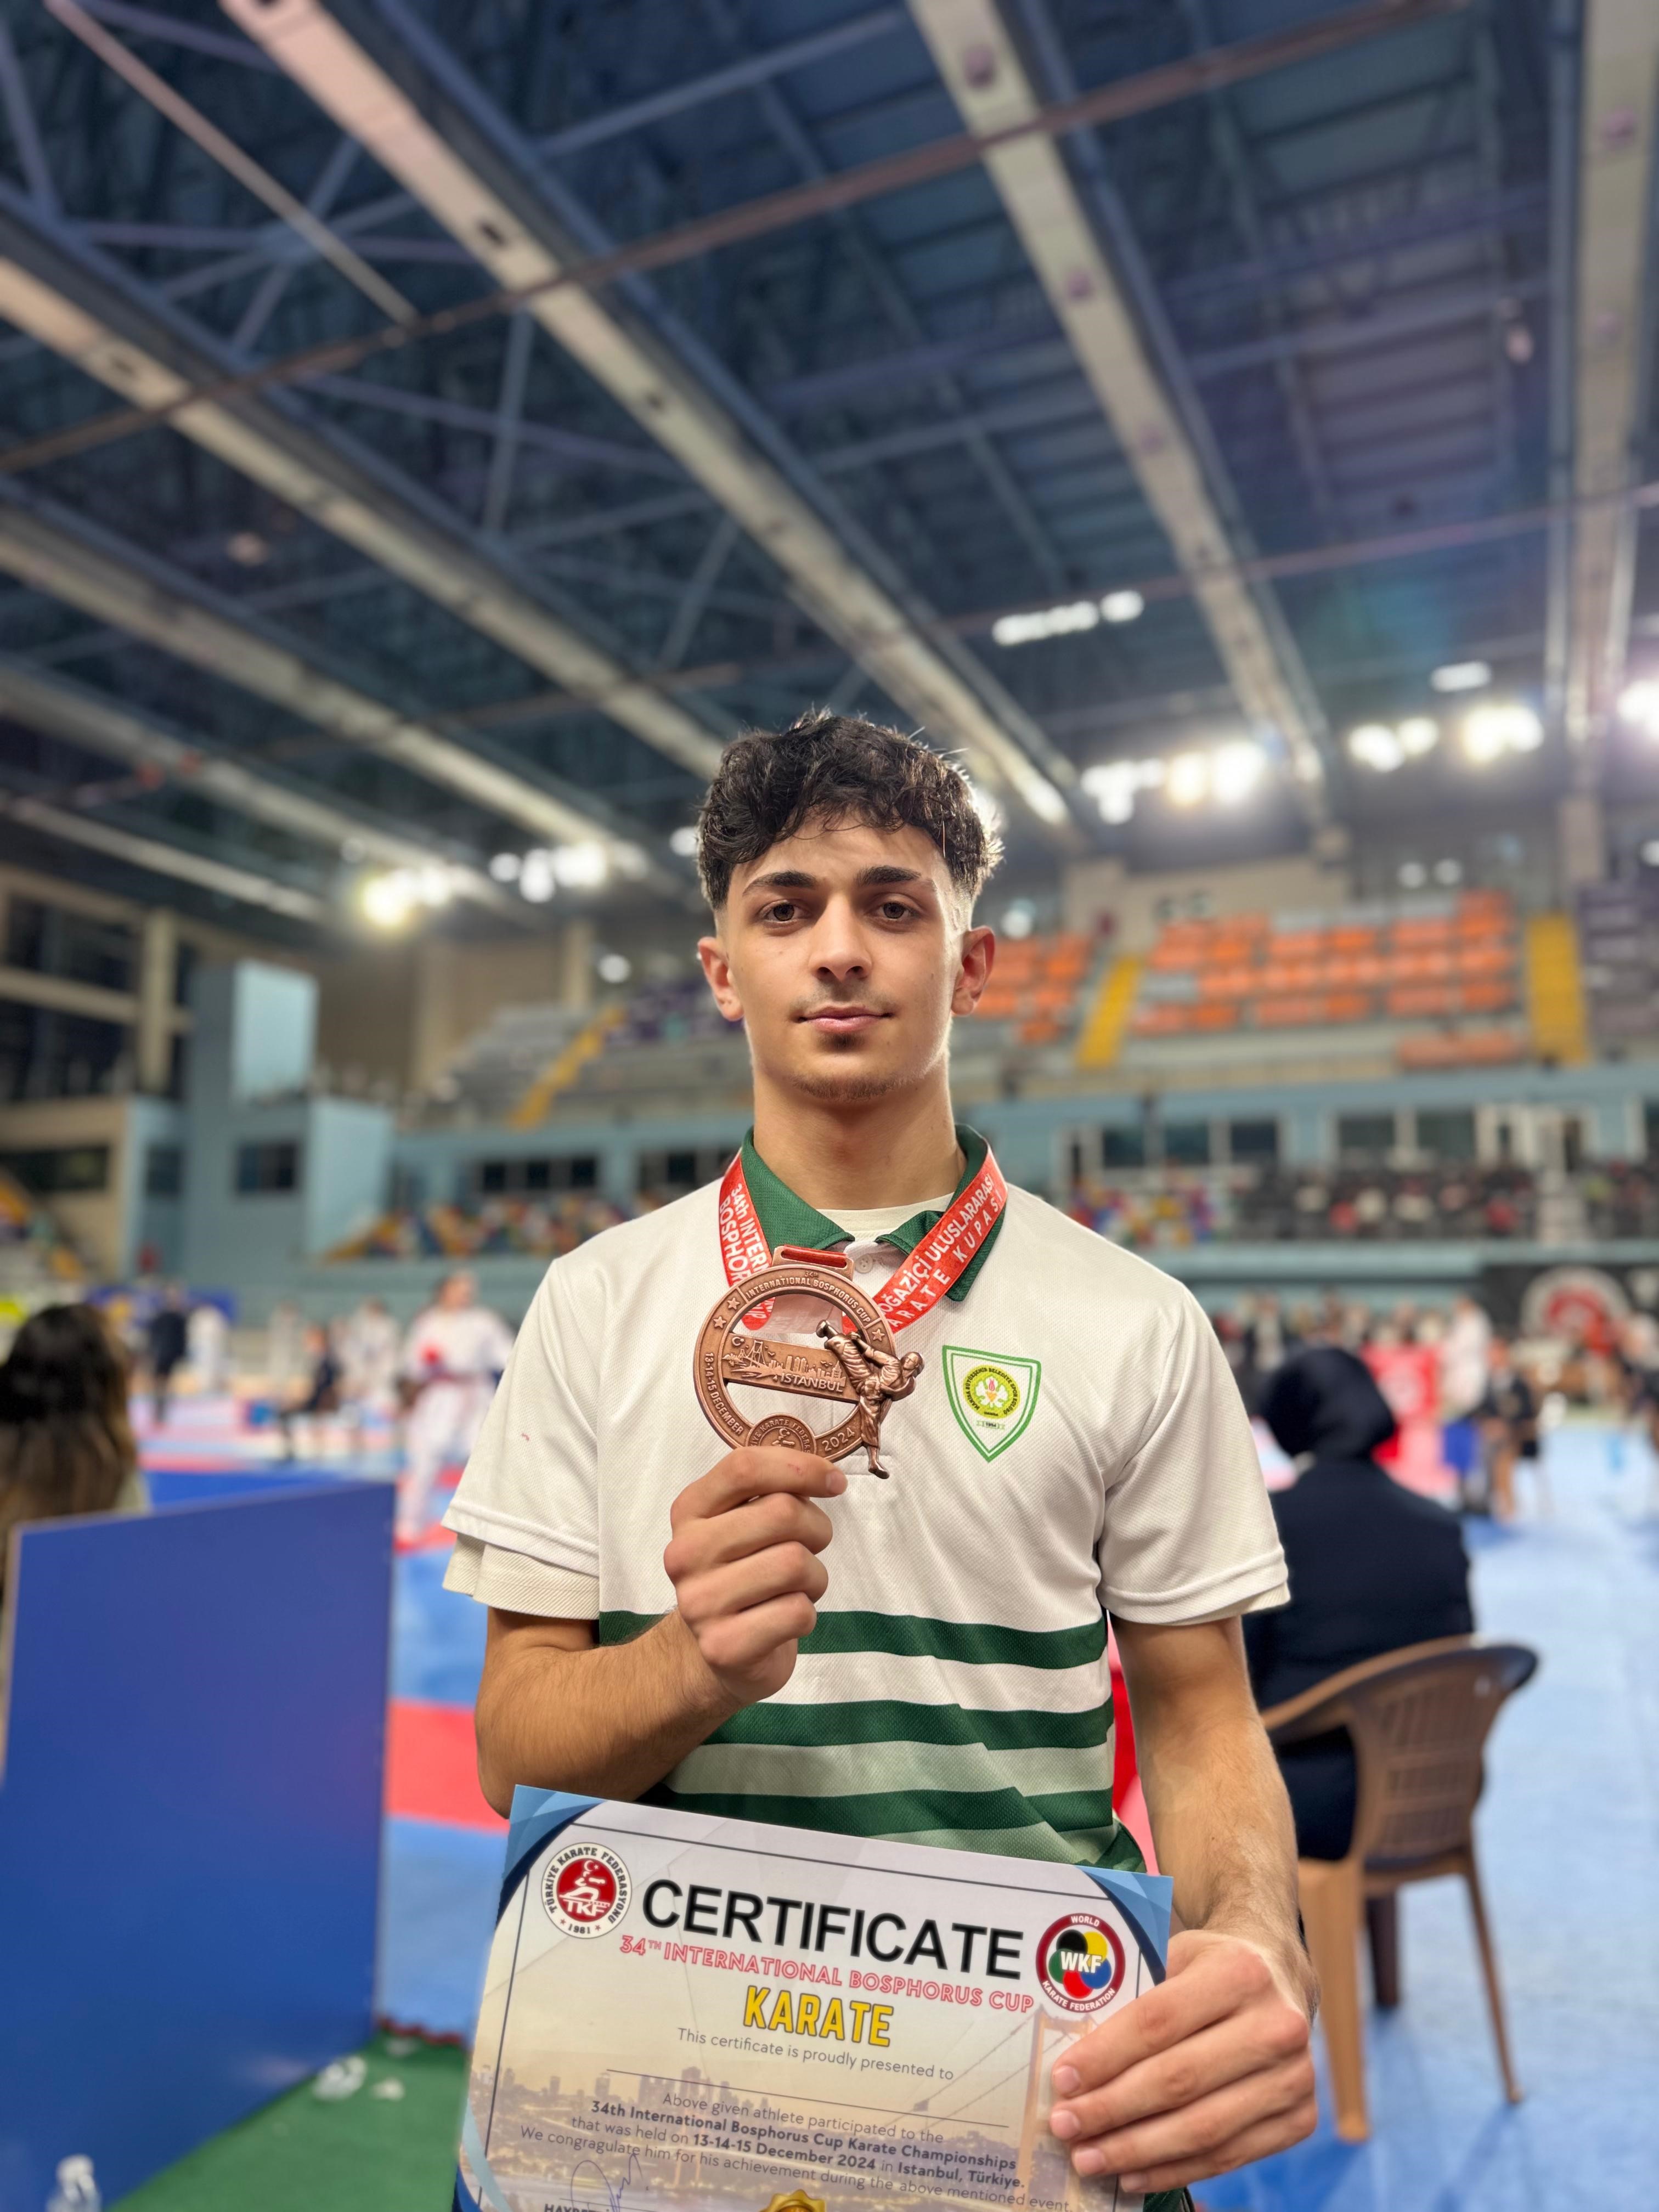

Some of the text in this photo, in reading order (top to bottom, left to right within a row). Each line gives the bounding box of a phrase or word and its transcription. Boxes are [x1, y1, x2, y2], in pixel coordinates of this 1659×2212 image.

[731, 1183, 749, 1220] 34th
[720, 1196, 752, 1281] BOSPHOR
[878, 1175, 994, 1314] OĞAZİÇİ ULUSLARARASI
[746, 1277, 871, 1323] INTERNATIONAL BOSPHORUS CUP
[887, 1268, 951, 1328] ARATE
[710, 1391, 744, 1435] DECEMBER
[759, 1419, 790, 1432] KARATE
[822, 1427, 855, 1452] 2024
[544, 1847, 628, 1924] TÜRKİYE KARATE FEDERASYONU
[563, 1899, 610, 1917] TKF
[568, 1923, 591, 1934] 1981
[642, 1879, 1024, 1980] CERTIFICATE
[1071, 1915, 1101, 1927] WORLD
[664, 1942, 843, 1987] INTERNATIONAL
[849, 1970, 984, 2006] BOSPHORUS
[989, 1990, 1034, 2013] CUP
[1060, 1951, 1103, 1974] WKF
[743, 1985, 894, 2047] KARATE
[1042, 1980, 1116, 2011] KARATE FEDERATION
[678, 2027, 954, 2080] This certificate is proudly presented to
[591, 2100, 1017, 2170] 34th International Bosphorus Cup Karate Championships
[663, 2092, 944, 2143] Above given athlete participated to the
[521, 2125, 544, 2141] We
[549, 2133, 641, 2155] congragulate
[645, 2145, 670, 2160] him
[676, 2148, 696, 2163] for
[699, 2152, 720, 2166] his
[724, 2158, 816, 2179] achievement
[821, 2169, 866, 2190] during
[870, 2176, 894, 2190] the
[899, 2180, 943, 2196] above
[947, 2188, 1025, 2205] mentioned
[572, 2116, 1025, 2190] that was held on 13-14-15 December 2024 in Istanbul, Türkiye.
